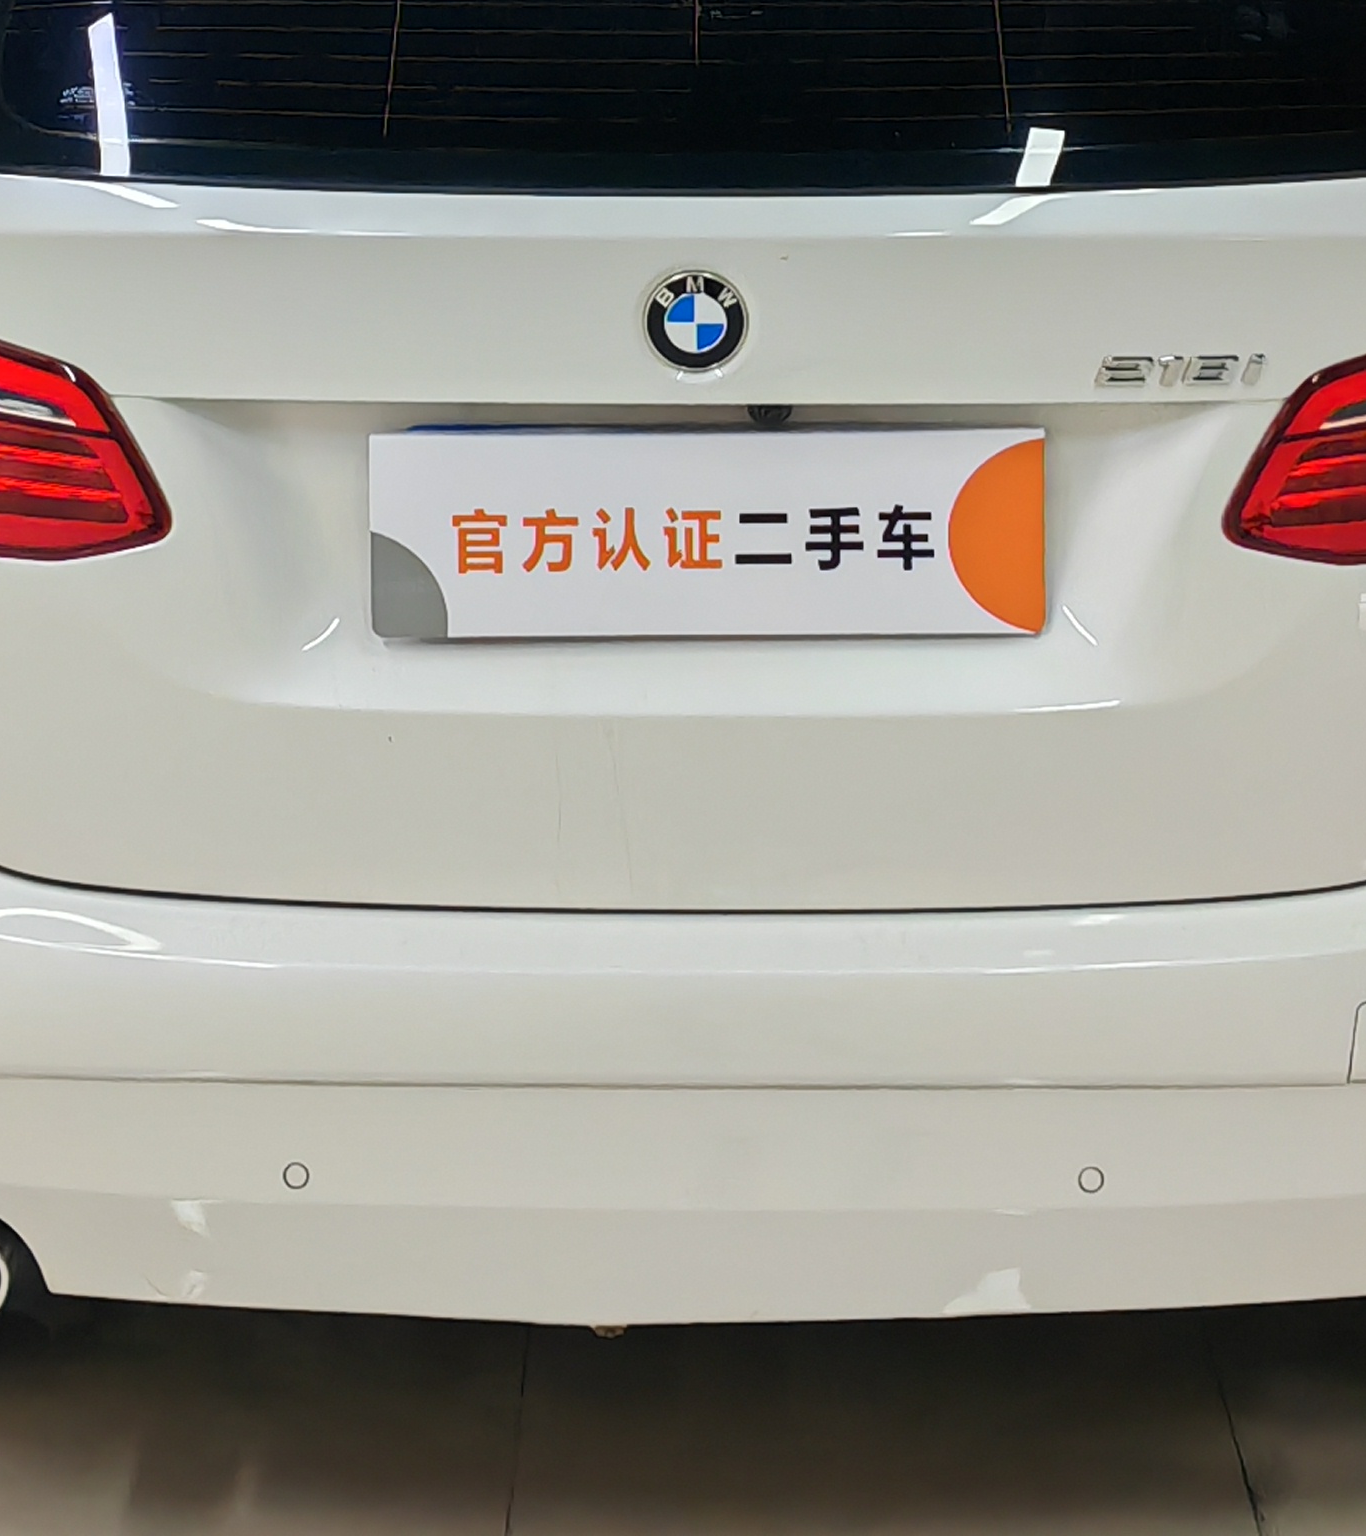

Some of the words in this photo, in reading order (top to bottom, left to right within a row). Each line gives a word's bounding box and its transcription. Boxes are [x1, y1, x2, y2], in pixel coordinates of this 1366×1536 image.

[655, 275, 737, 309] BMW
[1094, 353, 1266, 387] 218i
[451, 504, 935, 574] 官方认证二手车
